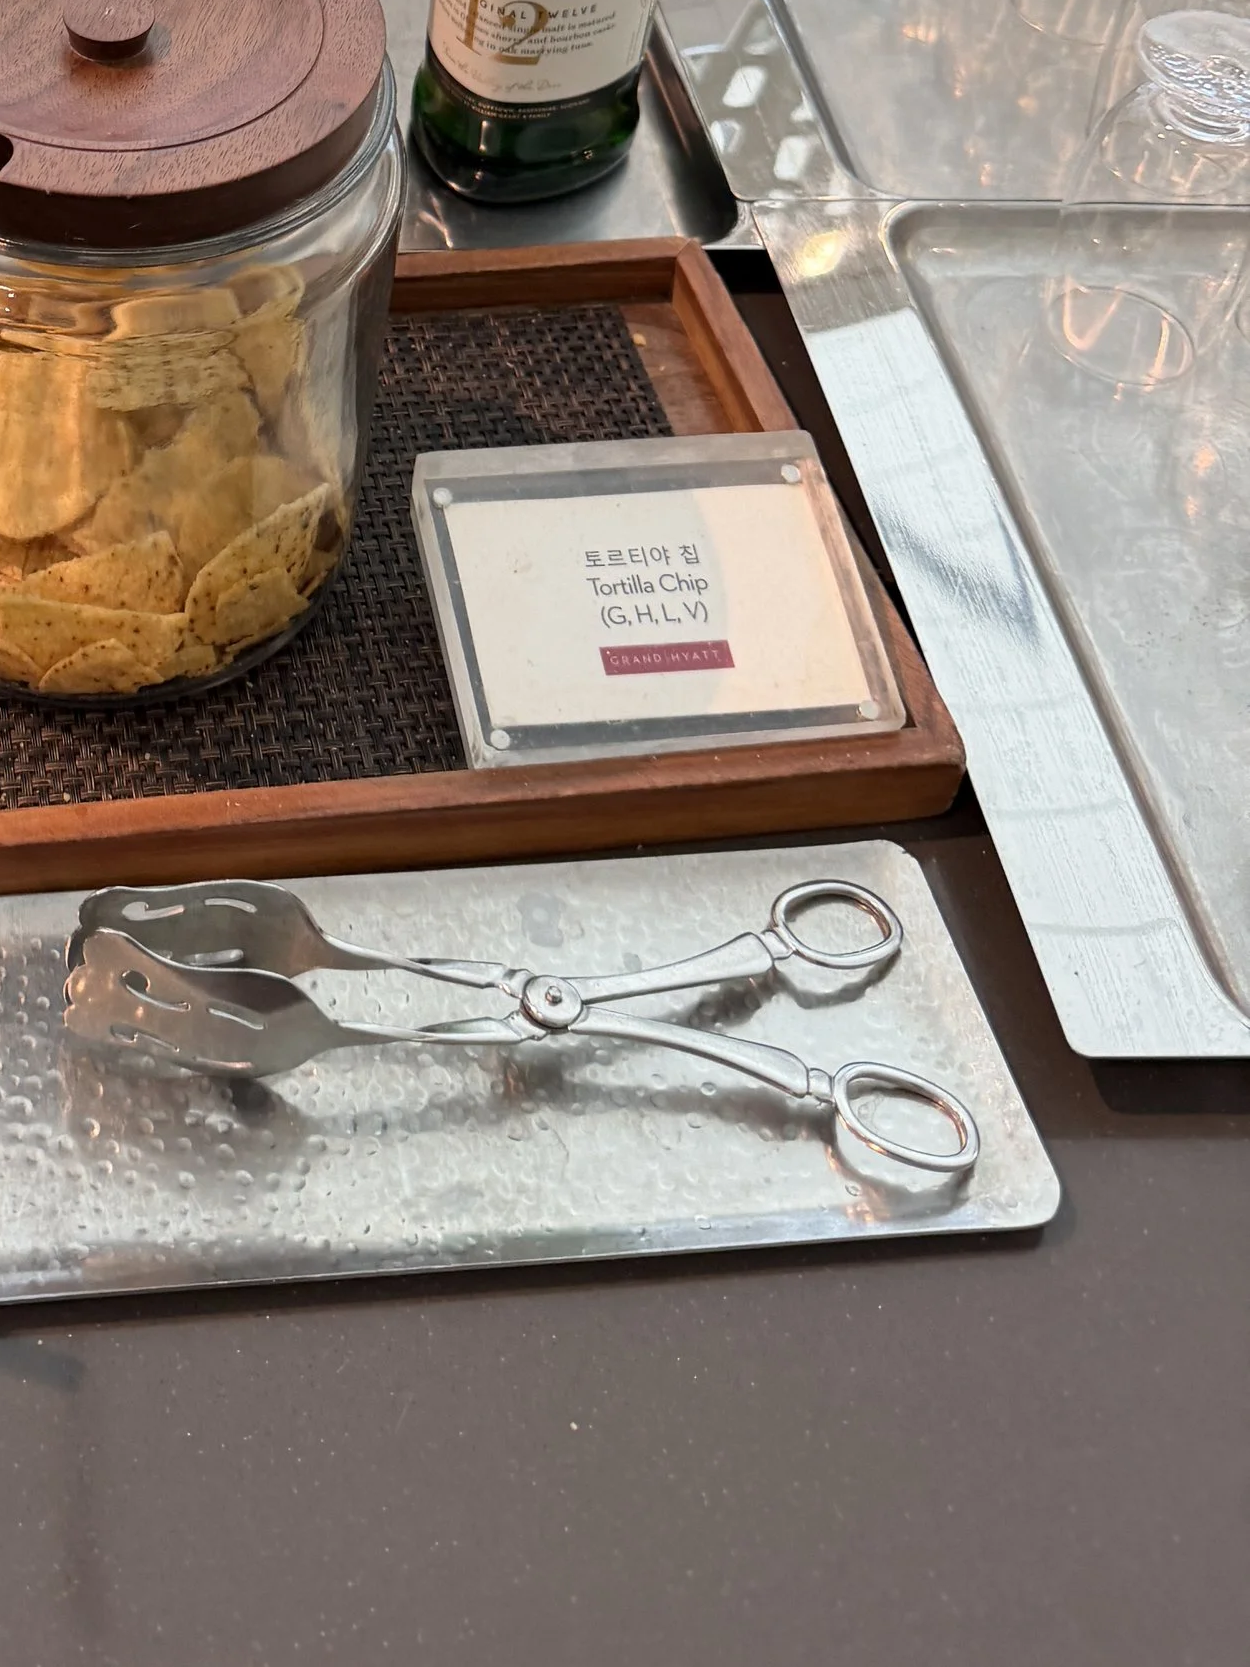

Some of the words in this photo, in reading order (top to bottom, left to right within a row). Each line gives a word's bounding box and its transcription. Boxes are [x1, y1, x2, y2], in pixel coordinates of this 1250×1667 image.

[538, 3, 598, 20] TWELVE
[584, 544, 670, 568] 토르티야
[678, 543, 700, 565] 칩
[586, 574, 655, 597] Tortilla
[658, 572, 709, 596] Chip
[609, 653, 662, 666] GRAND
[670, 649, 720, 662] HYATT
